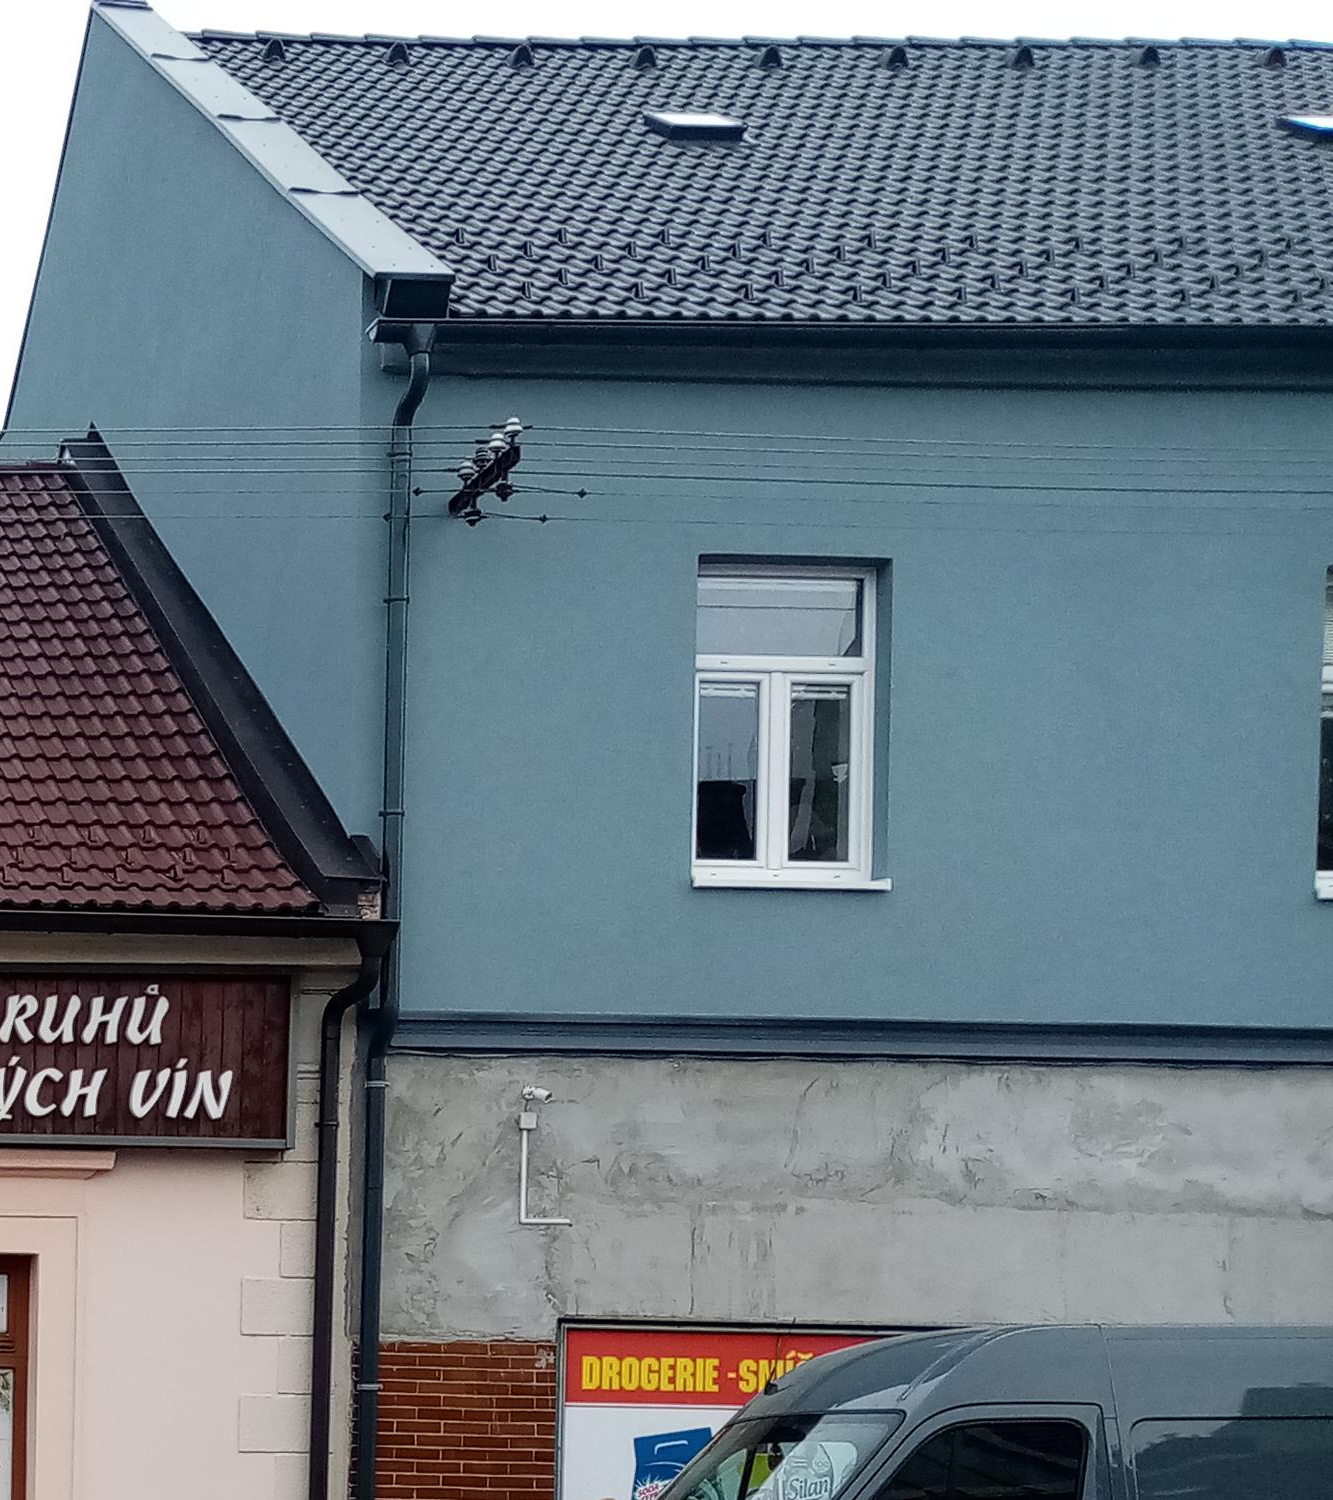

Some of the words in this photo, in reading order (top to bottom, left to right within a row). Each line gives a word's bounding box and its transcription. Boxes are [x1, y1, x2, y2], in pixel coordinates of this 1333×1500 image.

[129, 1058, 234, 1121] VÍN
[581, 1355, 720, 1393] DROGERIE
[787, 1479, 829, 1500] Silan
